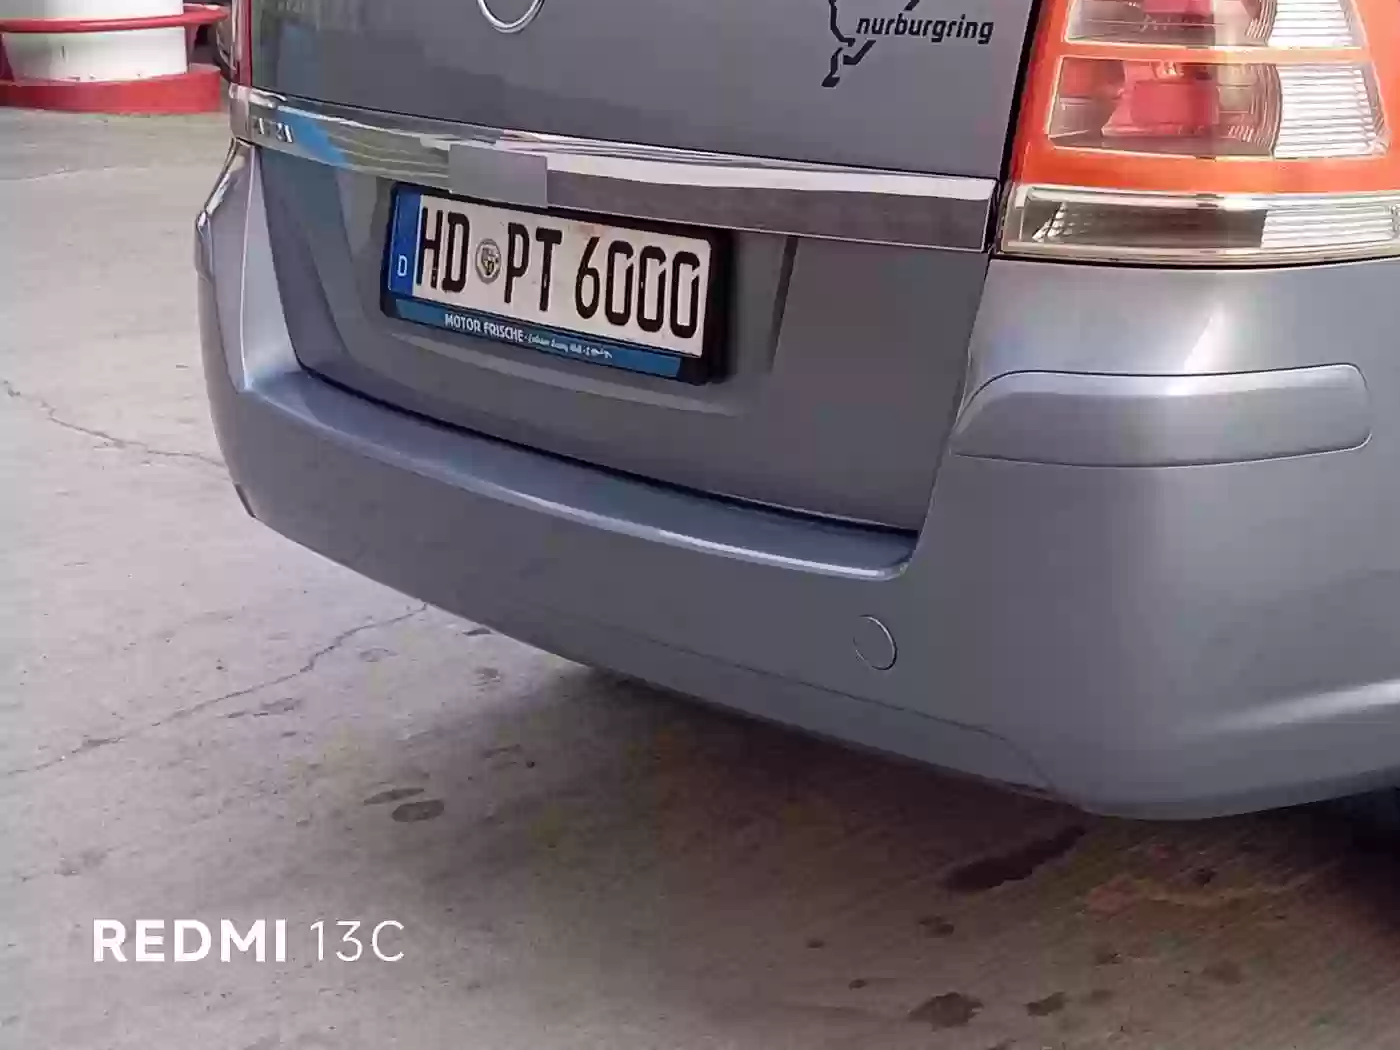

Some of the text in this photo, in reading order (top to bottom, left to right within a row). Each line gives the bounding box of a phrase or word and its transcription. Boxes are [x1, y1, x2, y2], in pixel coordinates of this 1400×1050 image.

[855, 13, 994, 45] nurburgring
[396, 255, 408, 278] D
[415, 207, 701, 340] HD PT 6000
[444, 313, 524, 343] MOTOR FRISCHE
